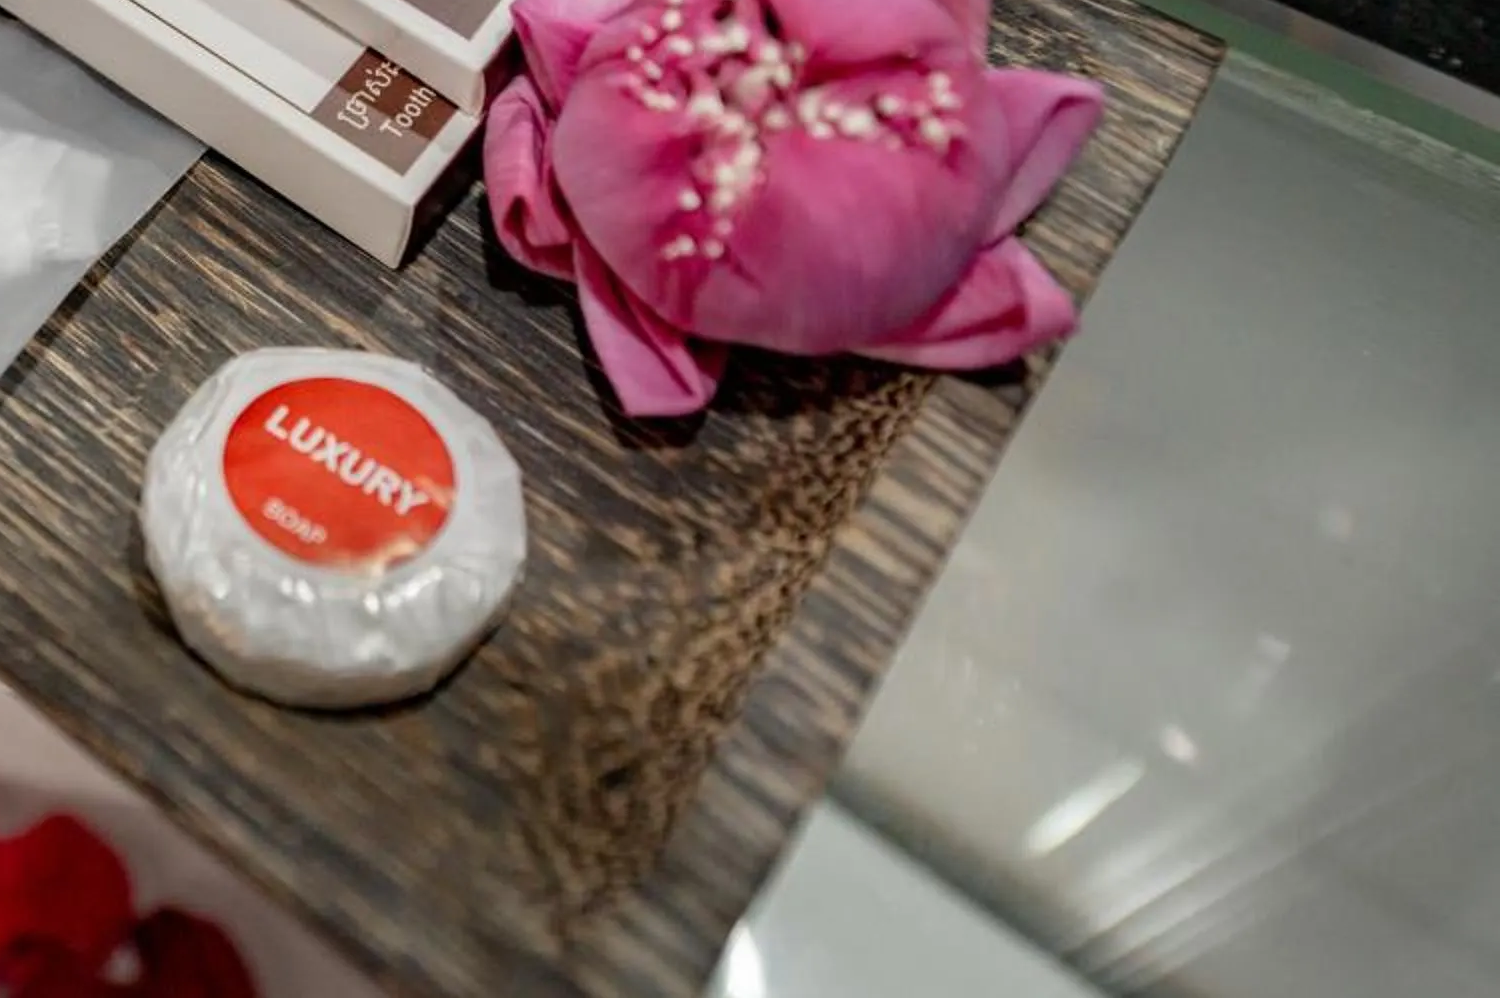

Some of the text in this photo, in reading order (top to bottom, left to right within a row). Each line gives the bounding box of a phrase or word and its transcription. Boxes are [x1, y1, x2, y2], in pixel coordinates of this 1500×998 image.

[379, 86, 437, 138] Tooth
[263, 404, 430, 518] LUXURY
[261, 496, 328, 546] SOAP
